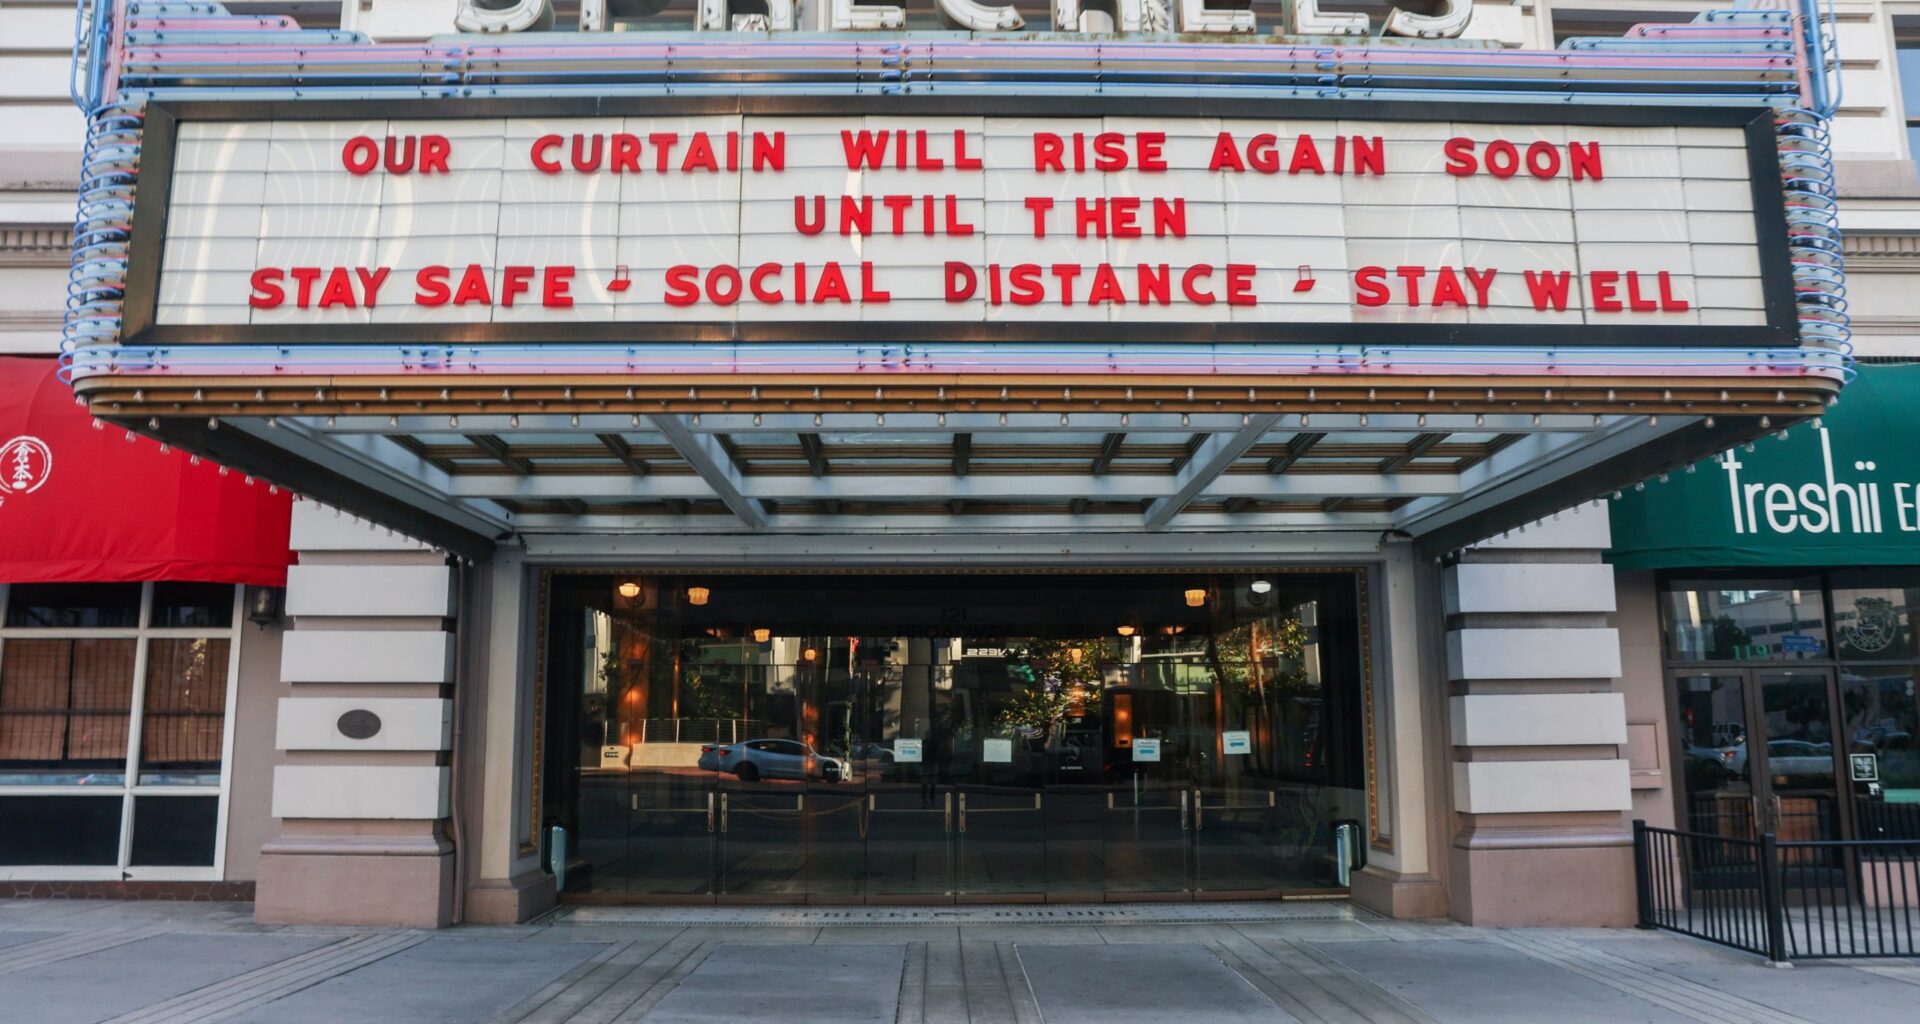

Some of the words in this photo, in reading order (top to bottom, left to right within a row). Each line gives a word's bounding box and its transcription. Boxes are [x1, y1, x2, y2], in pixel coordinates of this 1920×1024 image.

[342, 134, 451, 176] OUR
[531, 132, 785, 175] CURTAIN
[841, 130, 982, 172] WILL
[1034, 132, 1168, 175] RISE
[1209, 131, 1385, 176] AGAIN
[1444, 137, 1603, 182] SOON
[795, 194, 974, 237] UNTIL
[1024, 197, 1187, 240] THEN
[249, 266, 389, 309] STAY
[415, 264, 575, 309] SAFE
[664, 262, 891, 307] SOCIAL
[945, 263, 1257, 307] DISTANCE
[1354, 266, 1496, 308] STAY
[1525, 270, 1690, 313] WELL
[1721, 427, 1883, 534] freshii
[1893, 482, 1920, 532] E
[1732, 644, 1769, 660] 119
